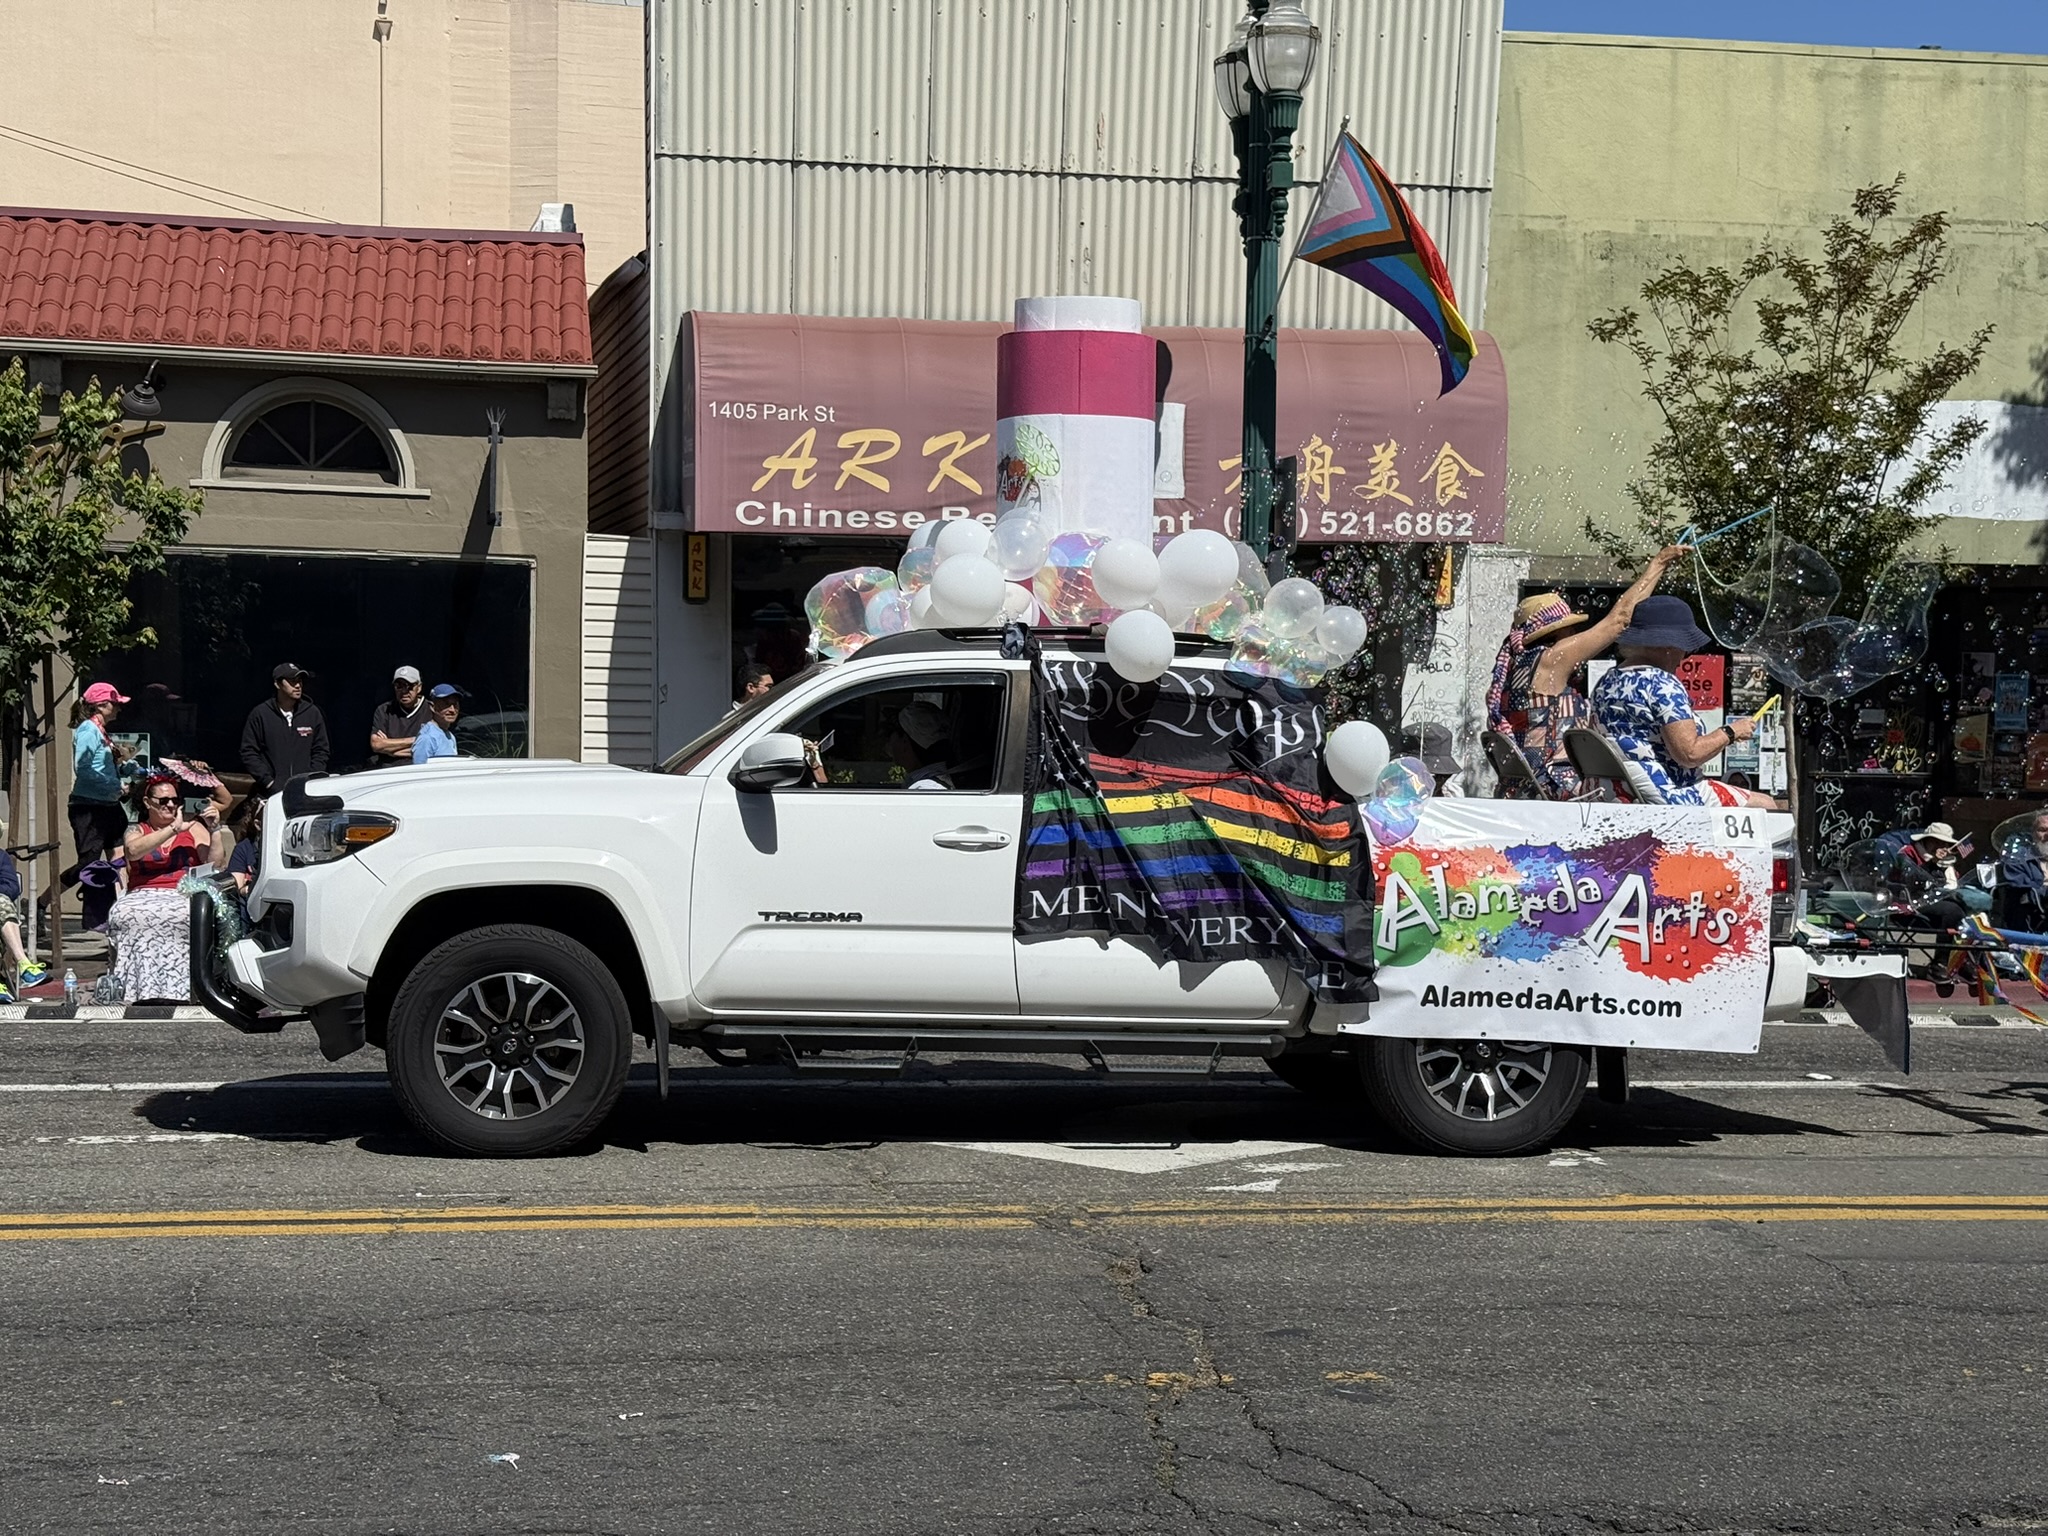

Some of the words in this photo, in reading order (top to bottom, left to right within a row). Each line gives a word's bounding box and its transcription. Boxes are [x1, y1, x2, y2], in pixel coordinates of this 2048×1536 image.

[709, 401, 757, 420] 1405
[763, 403, 809, 422] Park
[814, 405, 835, 423] St
[751, 427, 991, 496] ARK
[735, 500, 926, 529] Chinese
[1319, 510, 1474, 537] 521-6862
[291, 820, 307, 849] 84
[1724, 814, 1755, 839] 84
[758, 911, 862, 923] TACOMA
[1376, 862, 1603, 952] Alameda
[1583, 872, 1738, 964] Arts
[1419, 984, 1682, 1018] AlamedaArts.com
